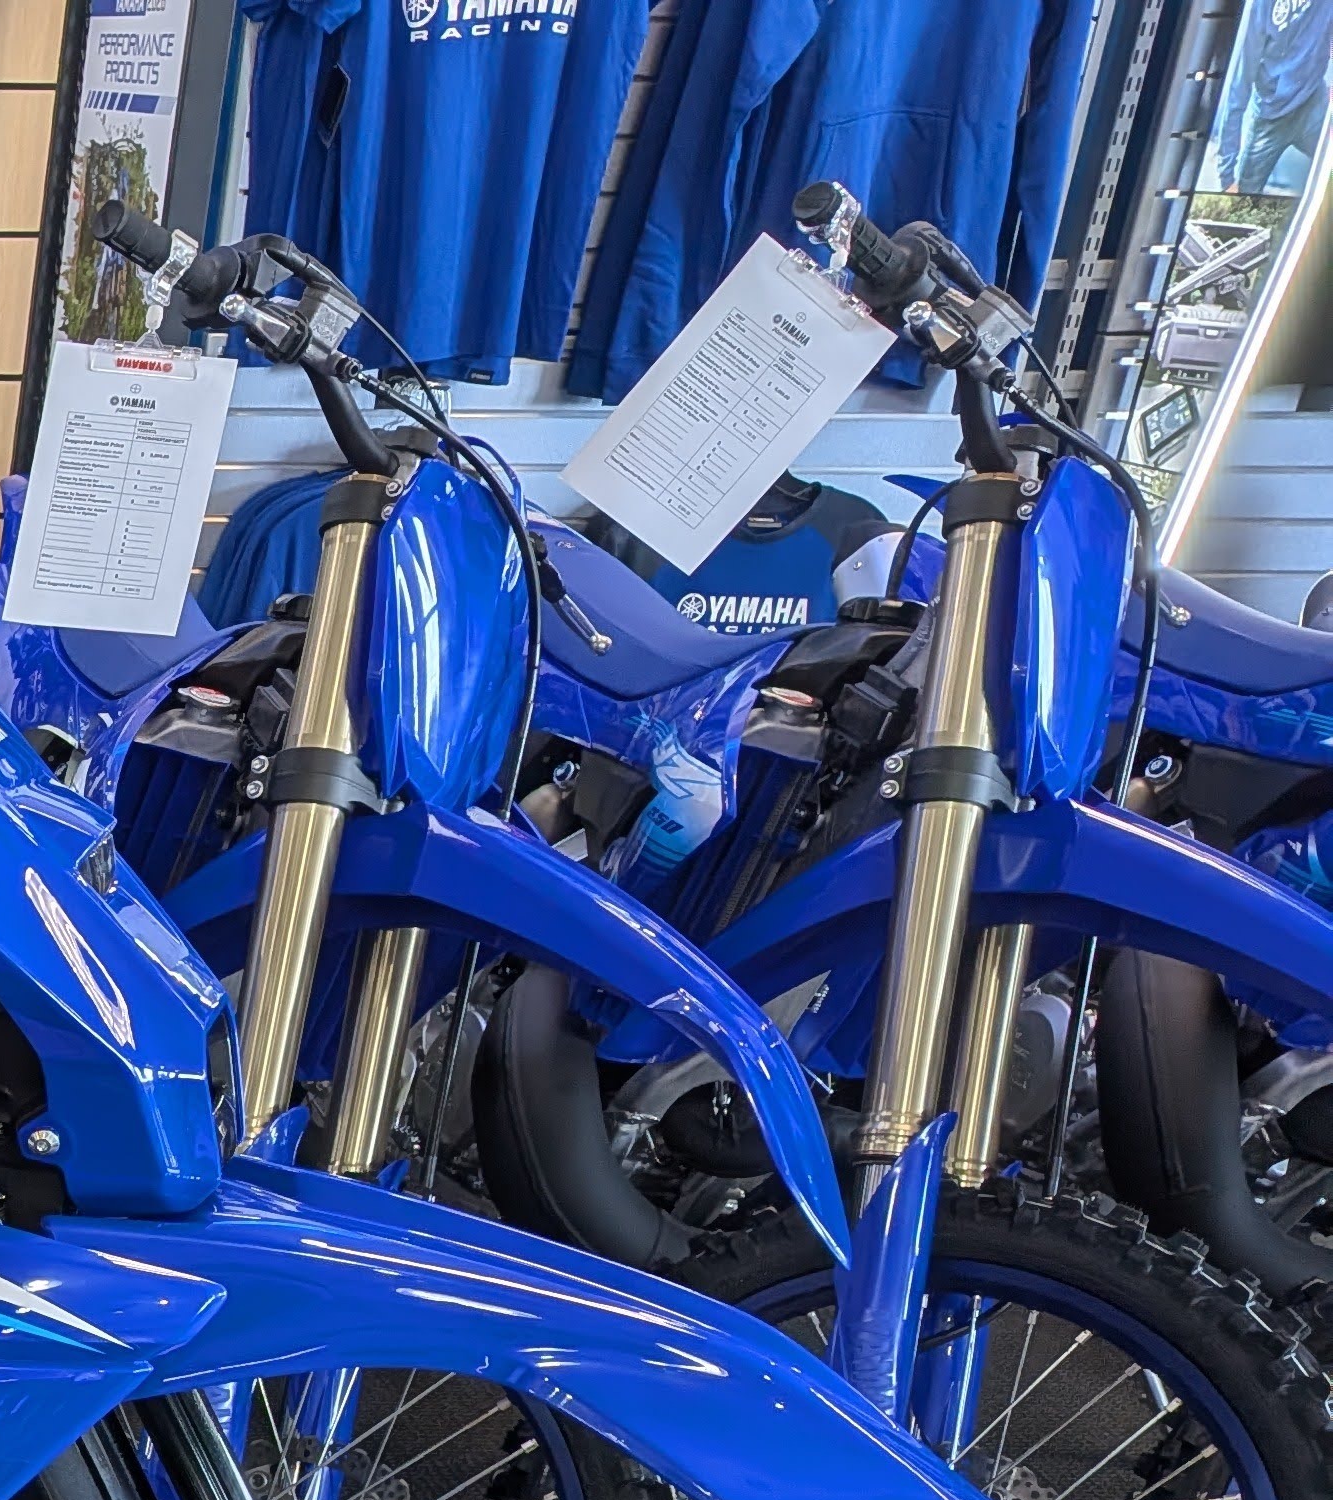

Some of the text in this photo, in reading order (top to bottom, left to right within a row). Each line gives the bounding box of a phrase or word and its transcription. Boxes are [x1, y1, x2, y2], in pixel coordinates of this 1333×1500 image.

[410, 20, 569, 42] RACING
[99, 33, 174, 57] PERFORMANCE
[105, 60, 160, 84] PRODUCTS
[780, 319, 810, 346] YAMAHA
[120, 397, 156, 410] YAMAHA
[709, 595, 809, 625] YAMAHA
